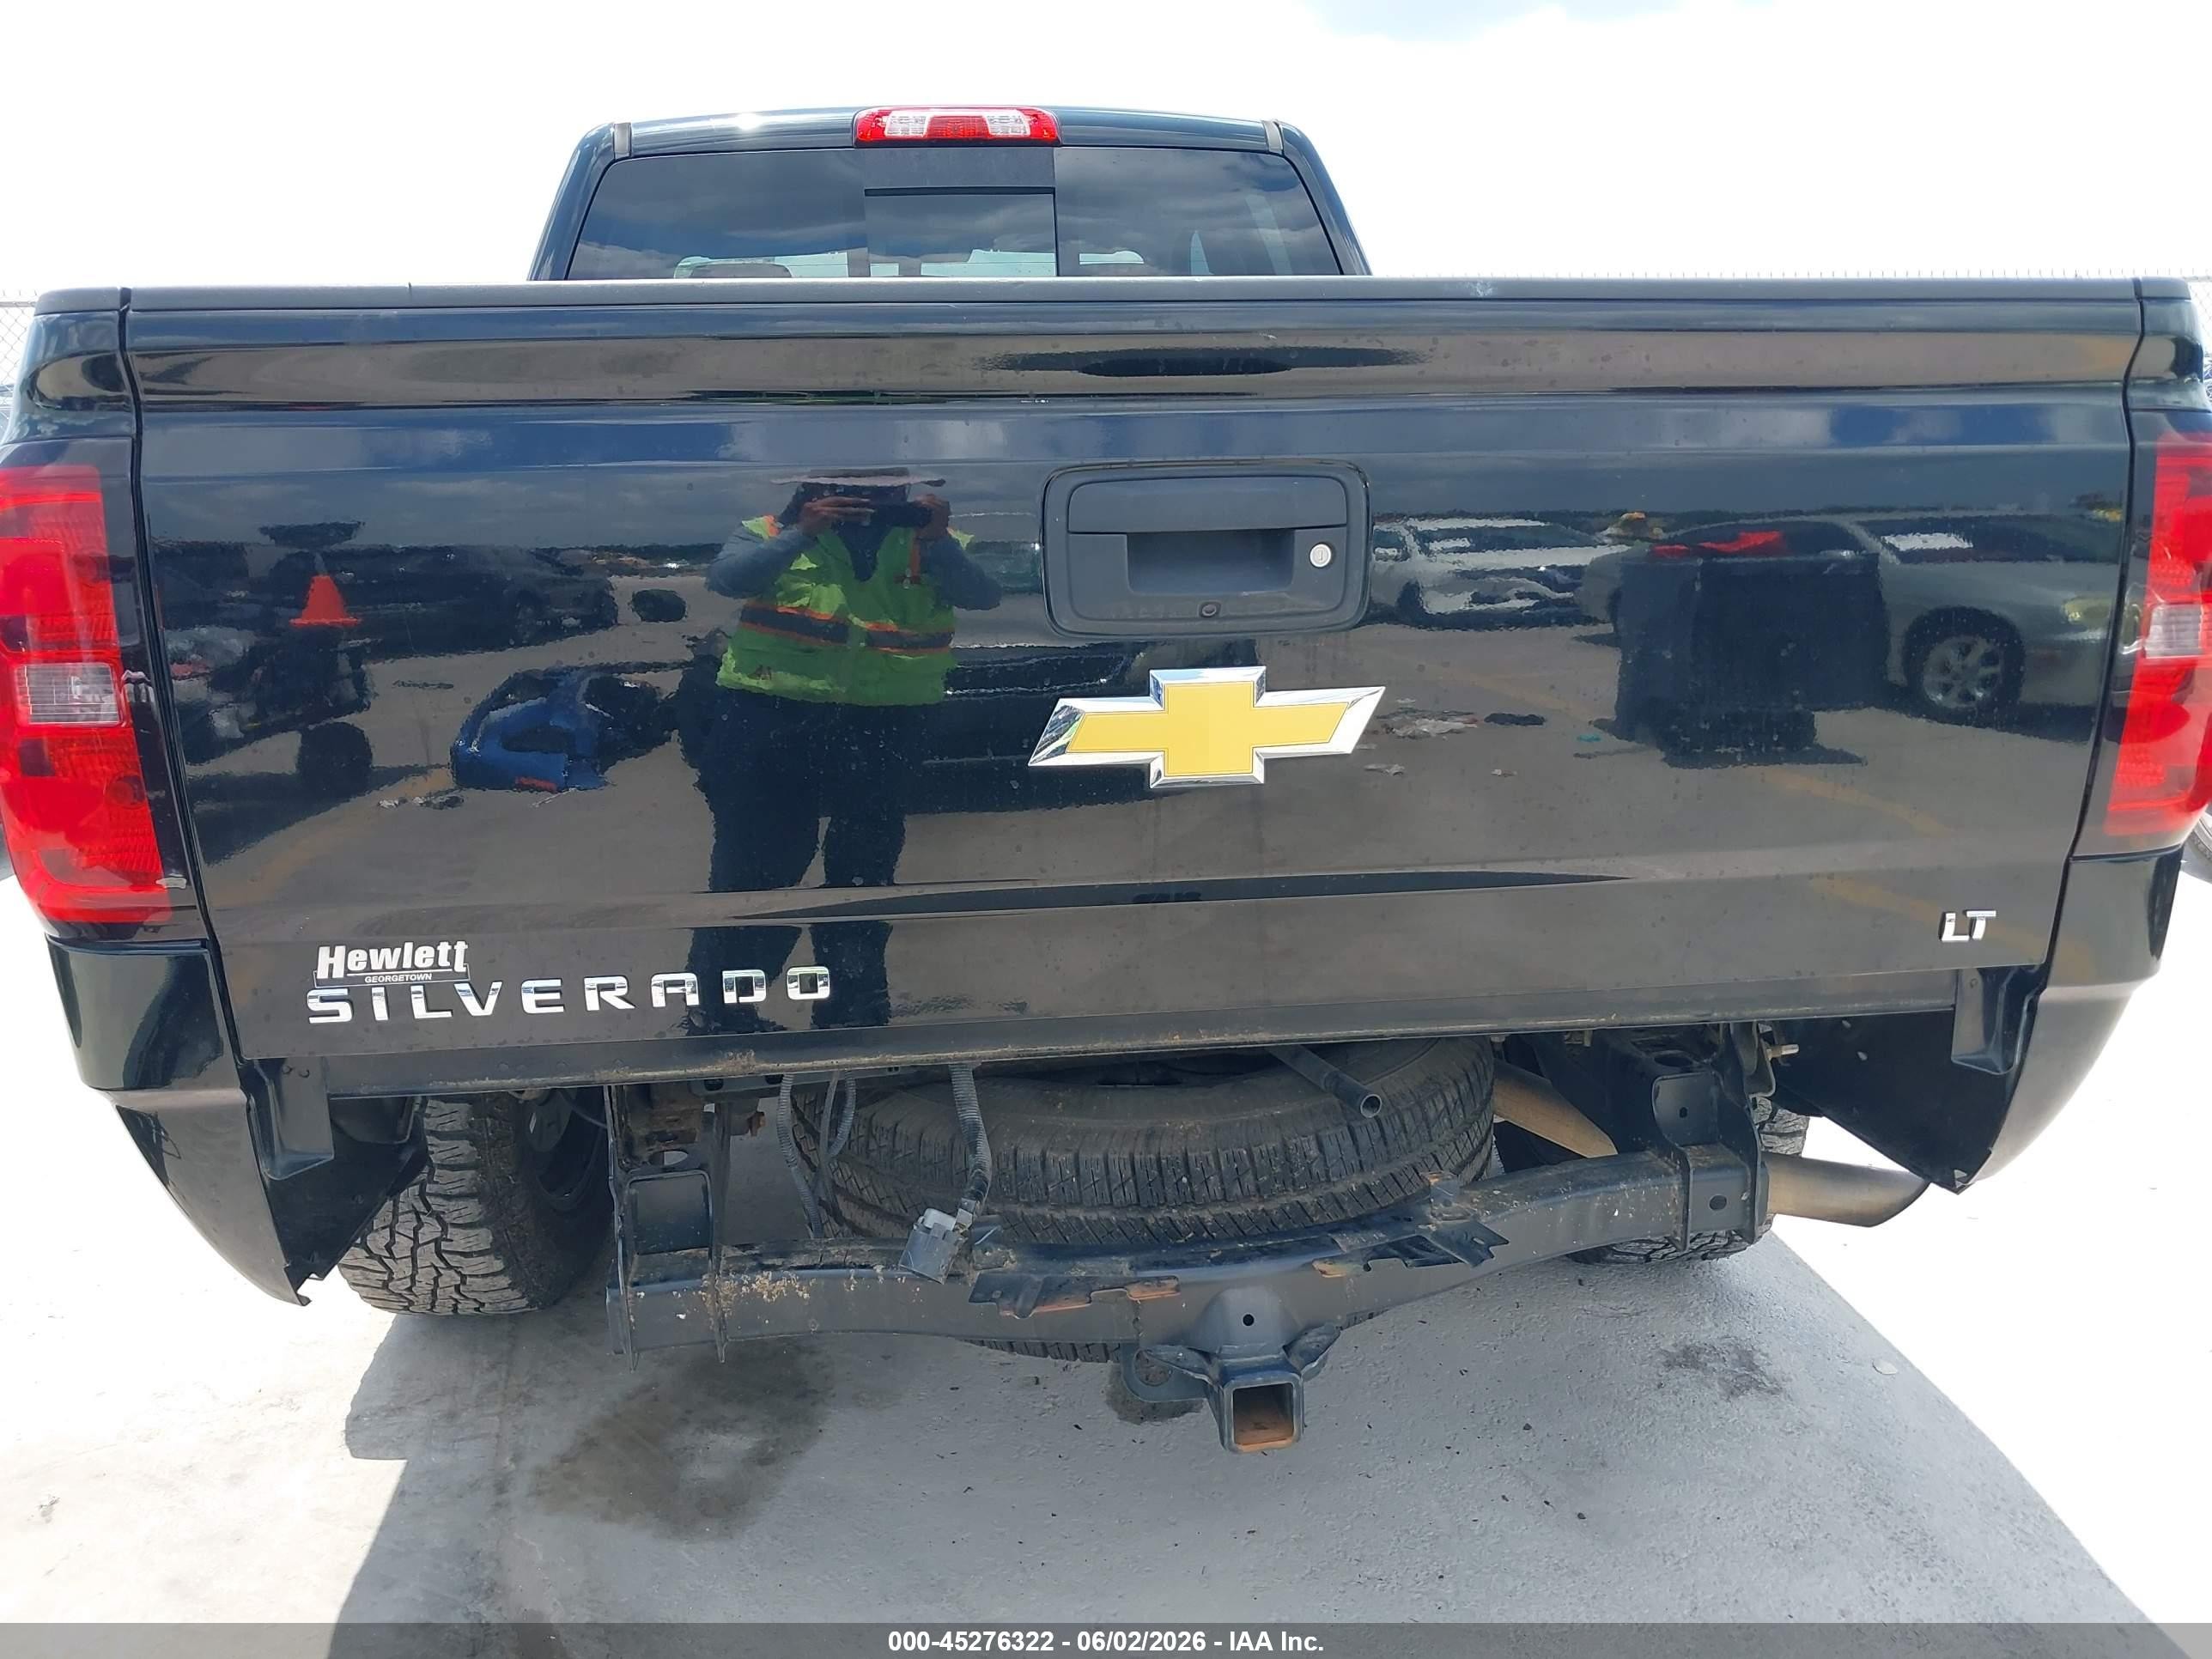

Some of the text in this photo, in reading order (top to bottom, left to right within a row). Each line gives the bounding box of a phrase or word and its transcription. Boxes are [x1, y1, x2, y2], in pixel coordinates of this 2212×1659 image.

[1939, 909, 1996, 942] LT
[316, 940, 469, 979] Hewlett
[306, 965, 831, 1024] SILVERADO
[364, 973, 433, 984] GEORGETOWN
